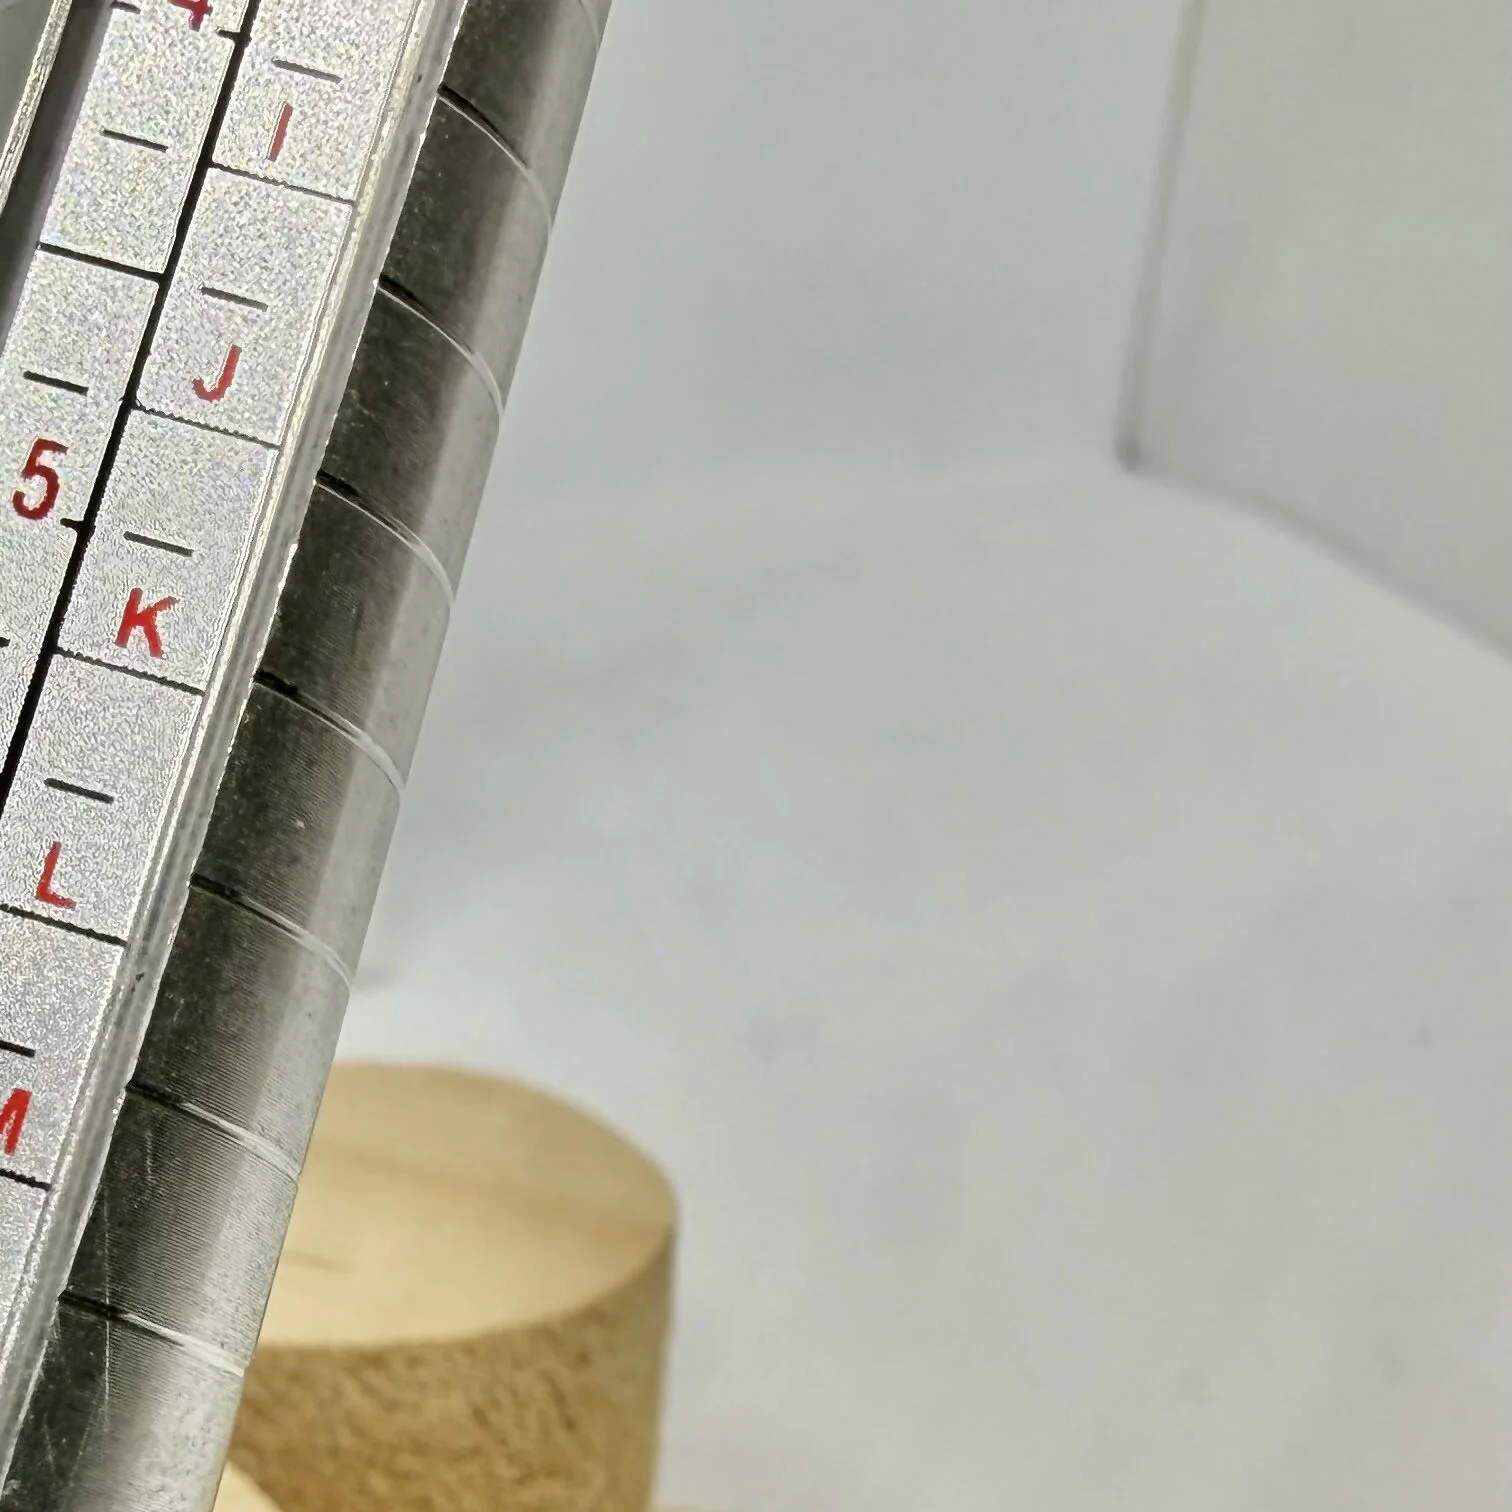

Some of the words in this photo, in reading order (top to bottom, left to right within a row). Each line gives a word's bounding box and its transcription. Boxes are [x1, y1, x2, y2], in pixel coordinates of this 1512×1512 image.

[268, 104, 293, 160] I
[193, 345, 242, 403] J
[11, 437, 68, 521] 5
[114, 587, 179, 658] K
[35, 841, 76, 909] L
